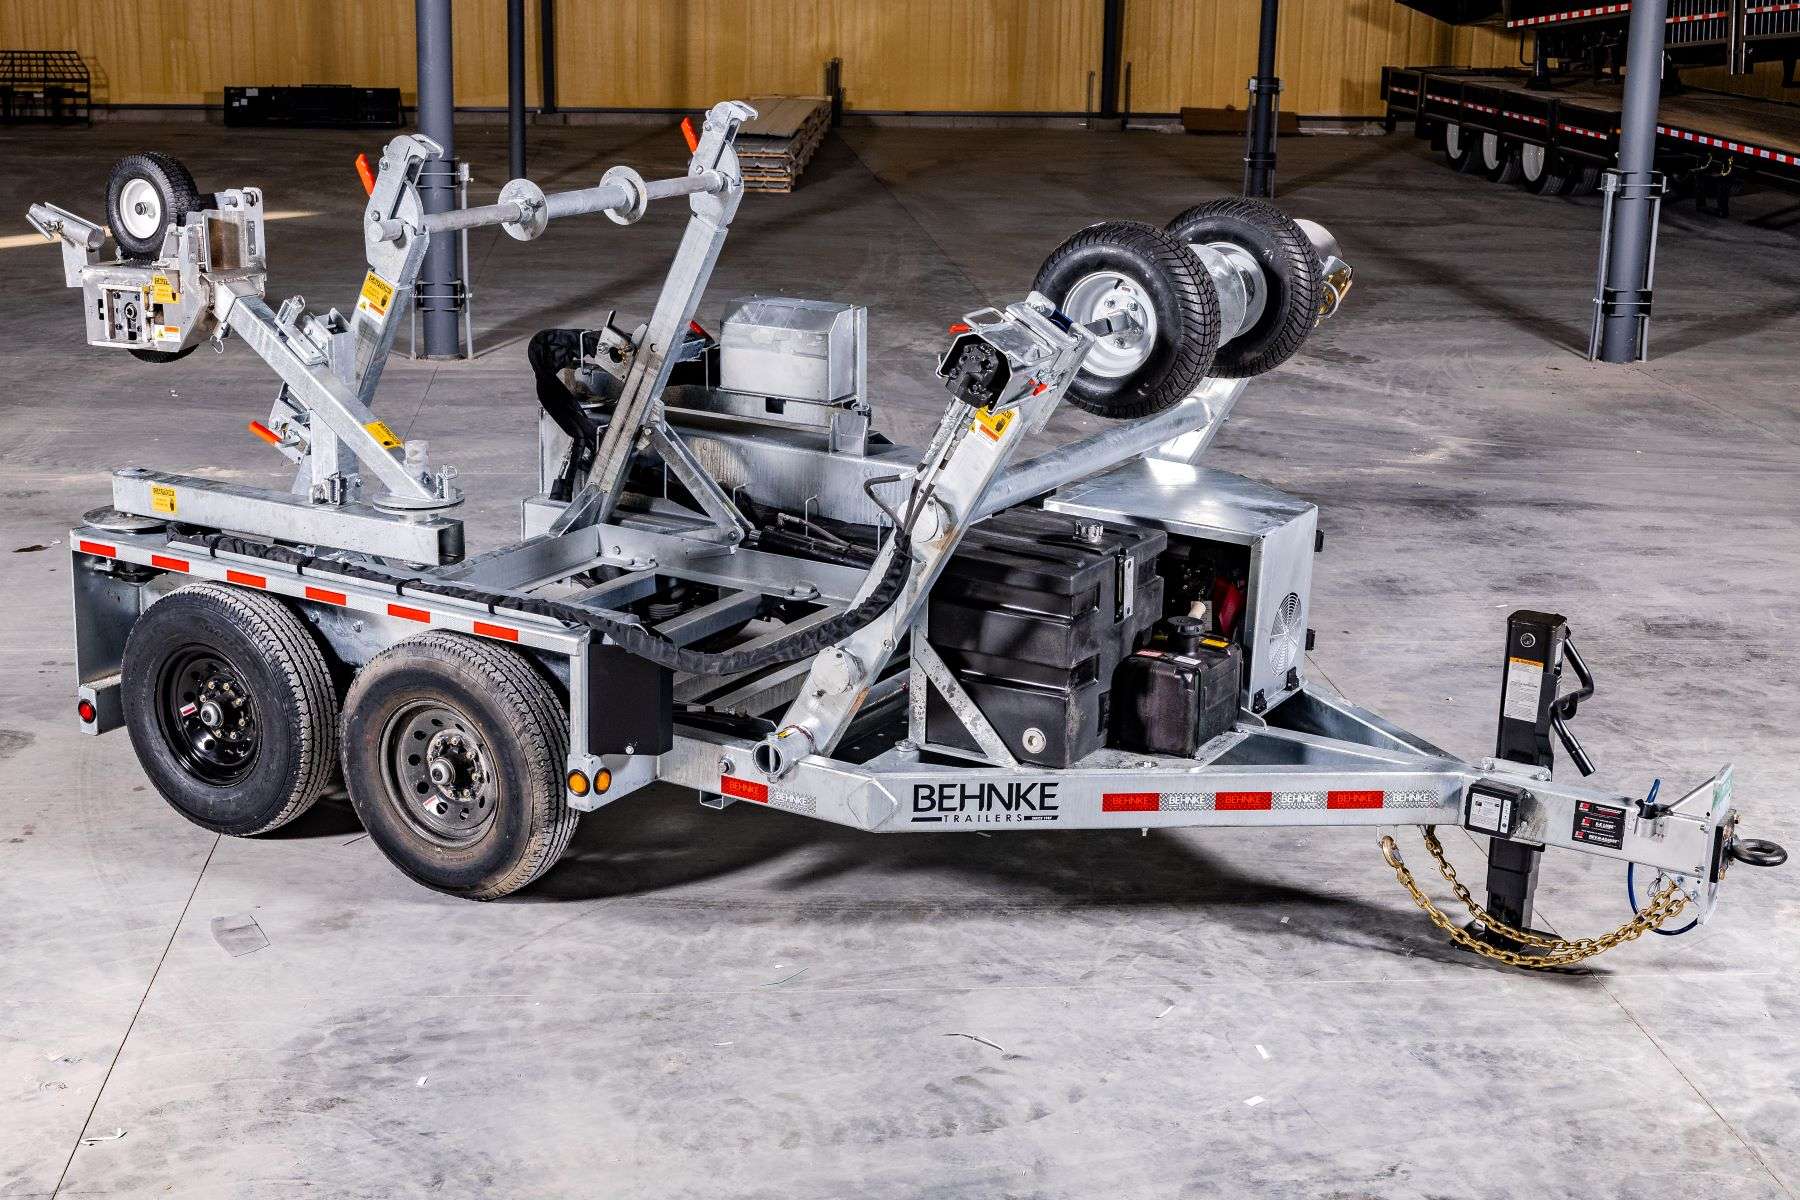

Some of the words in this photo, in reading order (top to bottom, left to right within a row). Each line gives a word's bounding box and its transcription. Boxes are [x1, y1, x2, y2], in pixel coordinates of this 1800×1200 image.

[729, 782, 760, 794] BEHNKE
[776, 791, 808, 805] BEHNKE
[913, 782, 1060, 812] BEHNKE
[1112, 797, 1150, 805] BEHNKE
[1168, 796, 1206, 804] BEHNKE
[1224, 795, 1262, 804] BEHNKE
[1281, 794, 1318, 803] BEHNKE
[1337, 794, 1374, 803] BEHNKE
[1392, 793, 1430, 802] BEHNKE
[943, 813, 1023, 824] TRAILERS
